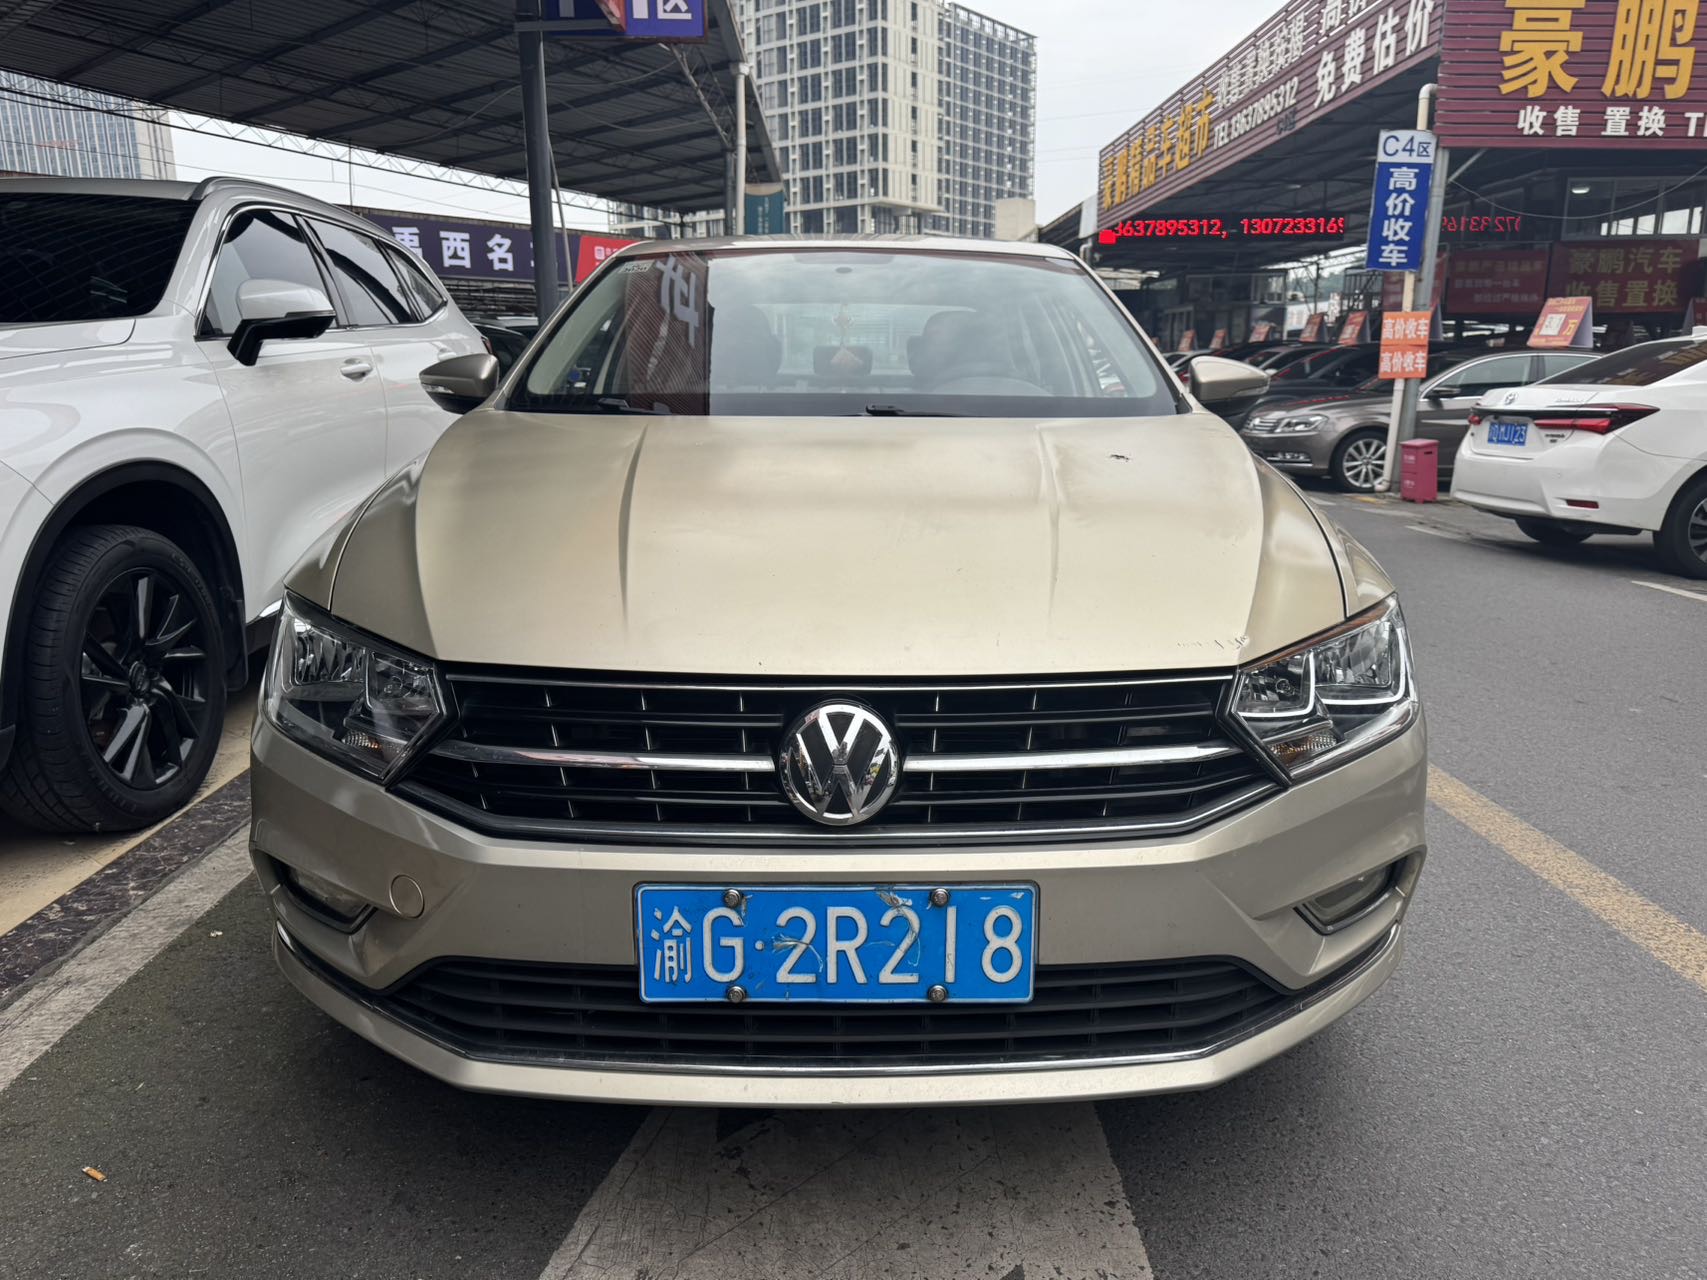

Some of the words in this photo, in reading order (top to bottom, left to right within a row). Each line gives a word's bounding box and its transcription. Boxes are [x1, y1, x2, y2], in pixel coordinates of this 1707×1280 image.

[1314, 0, 1435, 108] 免费估价
[1499, 0, 1700, 99] 豪鹏
[1517, 105, 1581, 136] 收售
[1601, 106, 1666, 136] 置换
[1684, 112, 1707, 137] T
[1383, 135, 1431, 157] C4区
[1379, 167, 1419, 266] 高价收车
[1569, 247, 1682, 274] 豪鹏汽车
[1382, 318, 1430, 340] 高价收车
[1380, 351, 1426, 373] 高价收车
